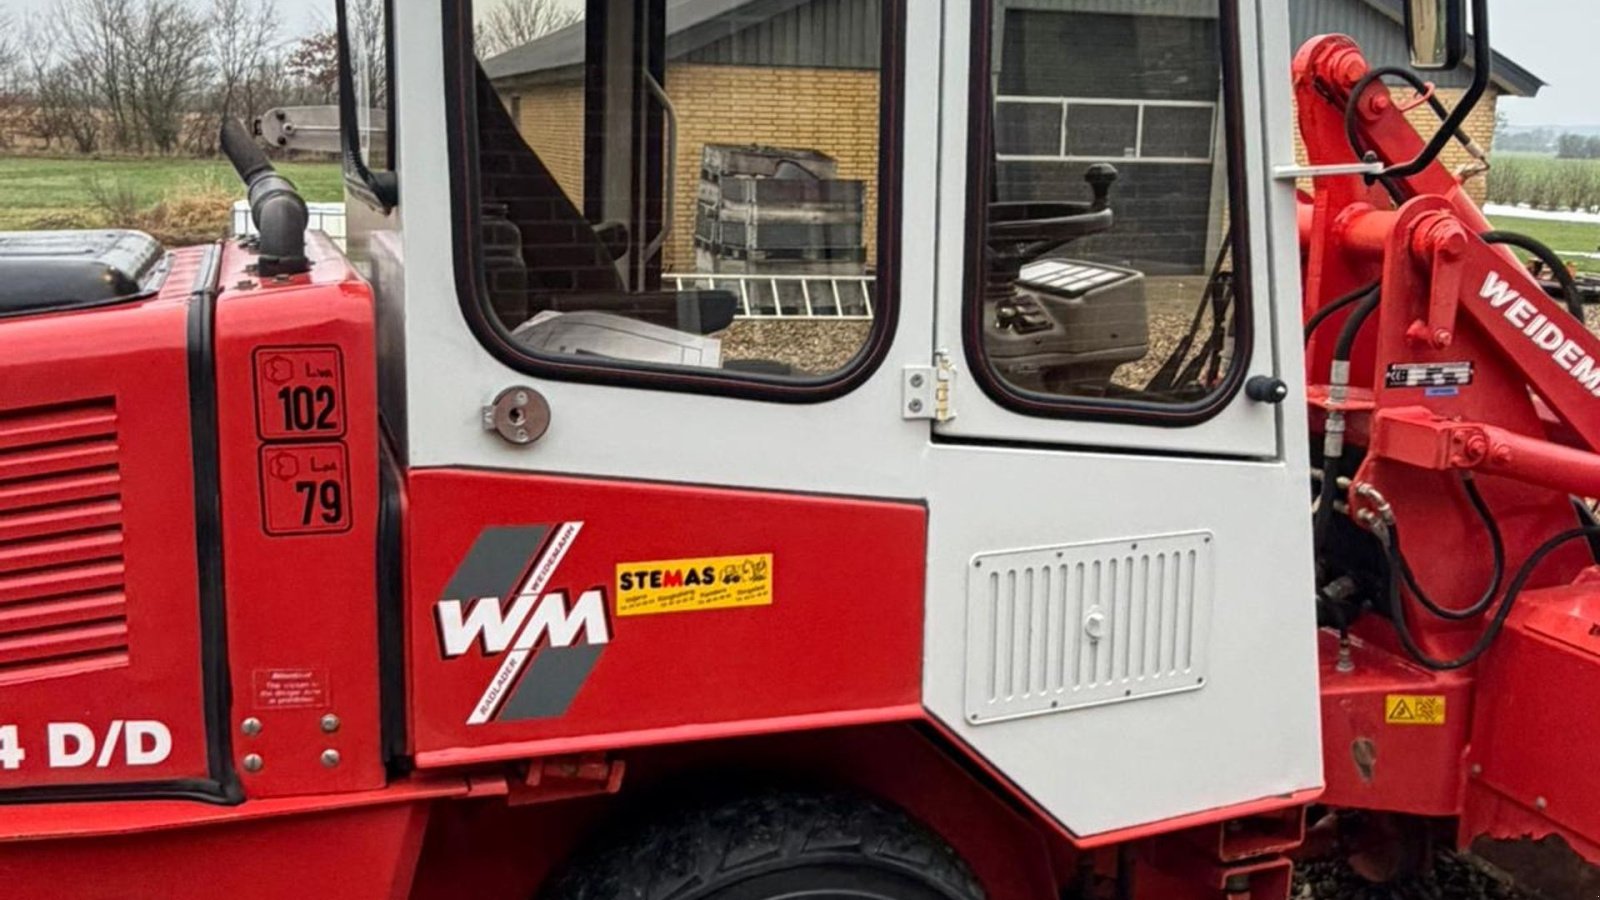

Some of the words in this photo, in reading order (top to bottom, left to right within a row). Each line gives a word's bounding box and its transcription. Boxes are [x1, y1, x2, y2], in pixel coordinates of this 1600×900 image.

[1479, 270, 1600, 397] WEIDEM
[278, 385, 337, 430] 102
[295, 480, 342, 525] 79
[530, 525, 576, 592] WEIDEMANN
[620, 566, 715, 591] STEMAS
[436, 589, 612, 658] WM
[479, 658, 518, 716] RADLADER
[47, 720, 172, 768] D/D
